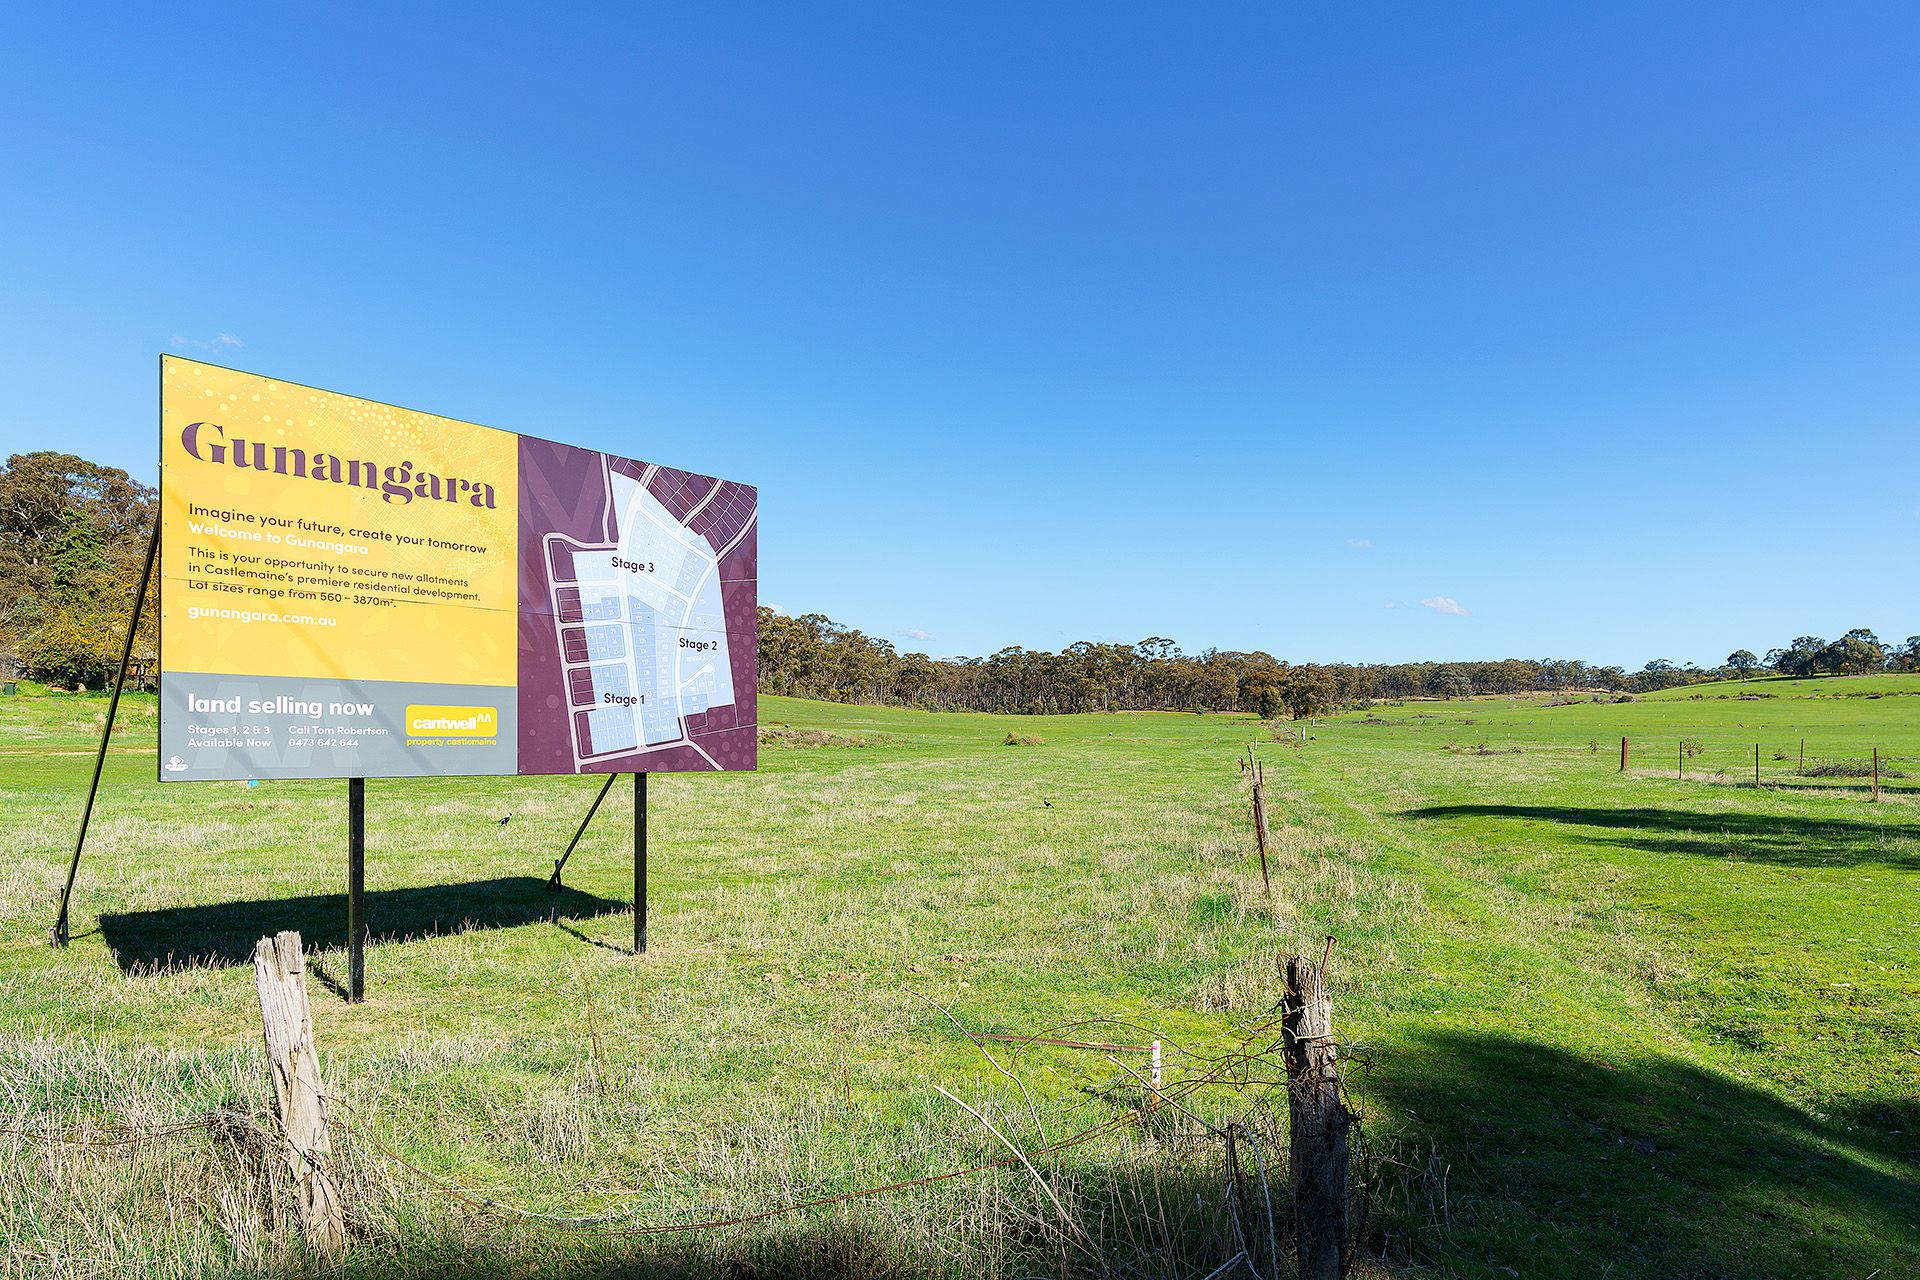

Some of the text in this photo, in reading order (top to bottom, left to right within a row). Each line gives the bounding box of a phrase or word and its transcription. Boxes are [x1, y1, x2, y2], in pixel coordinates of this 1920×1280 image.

[181, 422, 496, 509] Gunangara
[189, 503, 487, 554] Imagine your future, create your tomorrow
[188, 521, 368, 555] Welcome to Gunangara
[188, 547, 468, 587] This is your opportunity to secure new allotments
[611, 556, 655, 573] Stage 3
[188, 562, 481, 601] in Castlemaine’s premiere residential development.
[189, 580, 209, 589] Lot
[212, 582, 244, 594] sizes
[247, 587, 285, 599] range
[288, 589, 317, 600] from
[320, 592, 342, 602] 560
[188, 606, 337, 627] gunangara.com.au
[679, 637, 717, 652] Stage 2
[188, 693, 374, 719] land selling now
[604, 692, 645, 707] Stage 1
[187, 725, 270, 737] Stages 1, 2 & 3
[288, 726, 388, 735] Call Tom Robertson
[412, 717, 477, 730] cantwell
[187, 738, 272, 748] Available Now
[288, 738, 359, 747] 0473 642 644
[406, 738, 497, 747] property castlemaine
